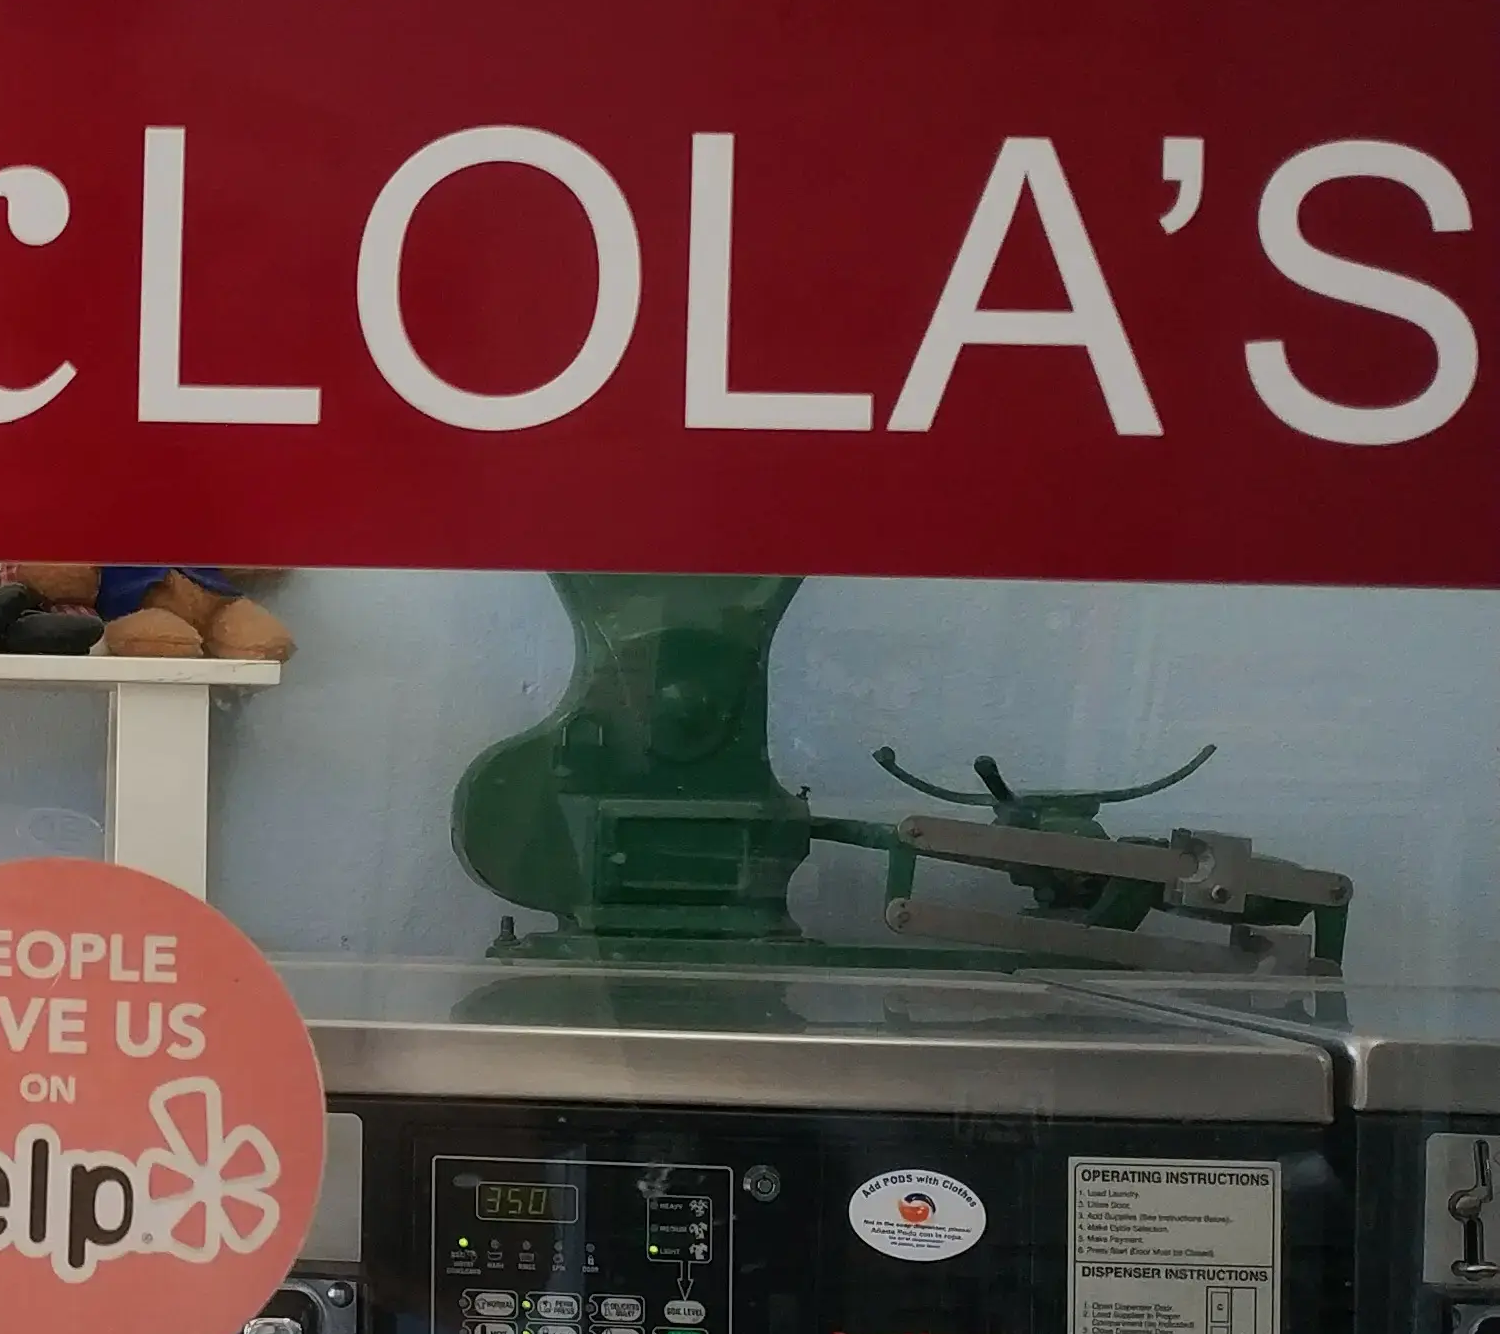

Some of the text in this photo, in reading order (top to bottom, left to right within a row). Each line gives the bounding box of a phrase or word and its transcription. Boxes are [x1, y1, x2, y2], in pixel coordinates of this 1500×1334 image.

[115, 1001, 207, 1060] US
[20, 1074, 76, 1103] ON
[861, 1174, 978, 1209] Add PODS with Clothes
[1081, 1169, 1270, 1187] OPERATING INSTRUCTIONS
[485, 1186, 548, 1216] 350
[1081, 1266, 1269, 1282] DISPENSER INSTRUCTIONS
[1216, 1303, 1225, 1311] C
